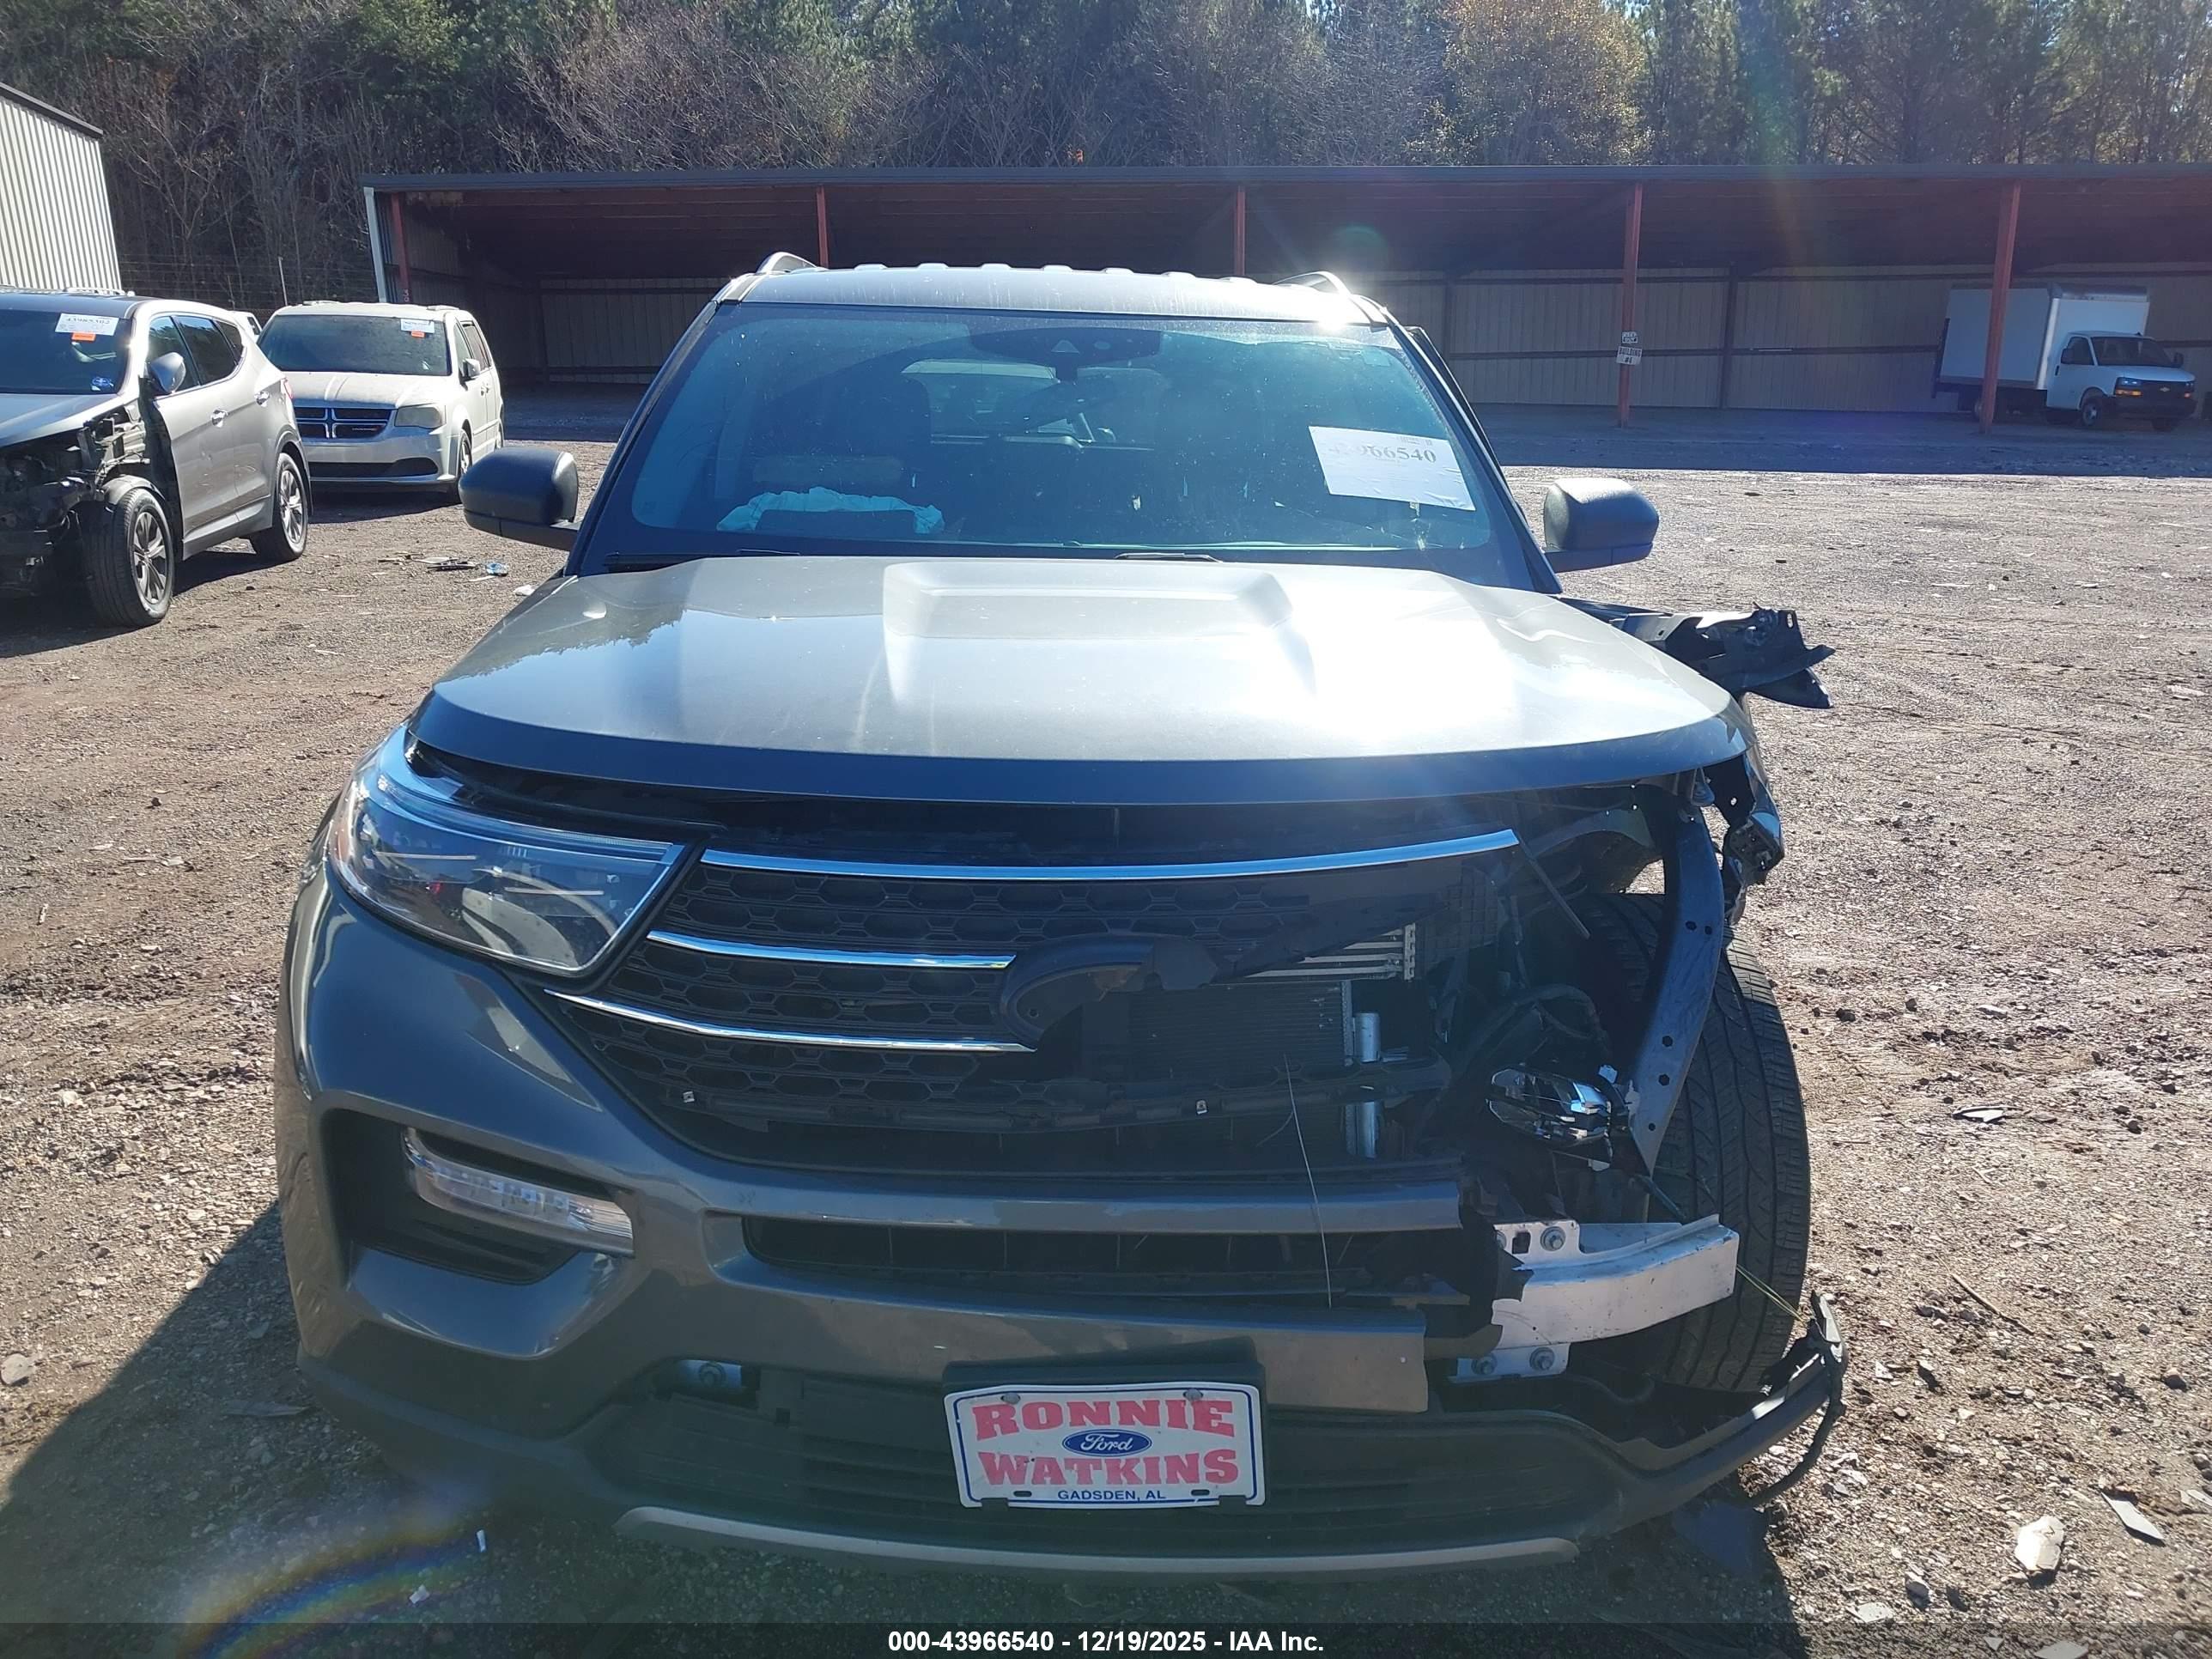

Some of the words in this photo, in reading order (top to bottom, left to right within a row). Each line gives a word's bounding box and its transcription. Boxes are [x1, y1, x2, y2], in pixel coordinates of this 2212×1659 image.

[971, 1399, 1235, 1442] RONNIE
[1079, 1432, 1133, 1451] Ford
[978, 1449, 1239, 1486] WATKINS
[1057, 1490, 1140, 1501] GADSDEN,
[1146, 1490, 1166, 1499] AL
